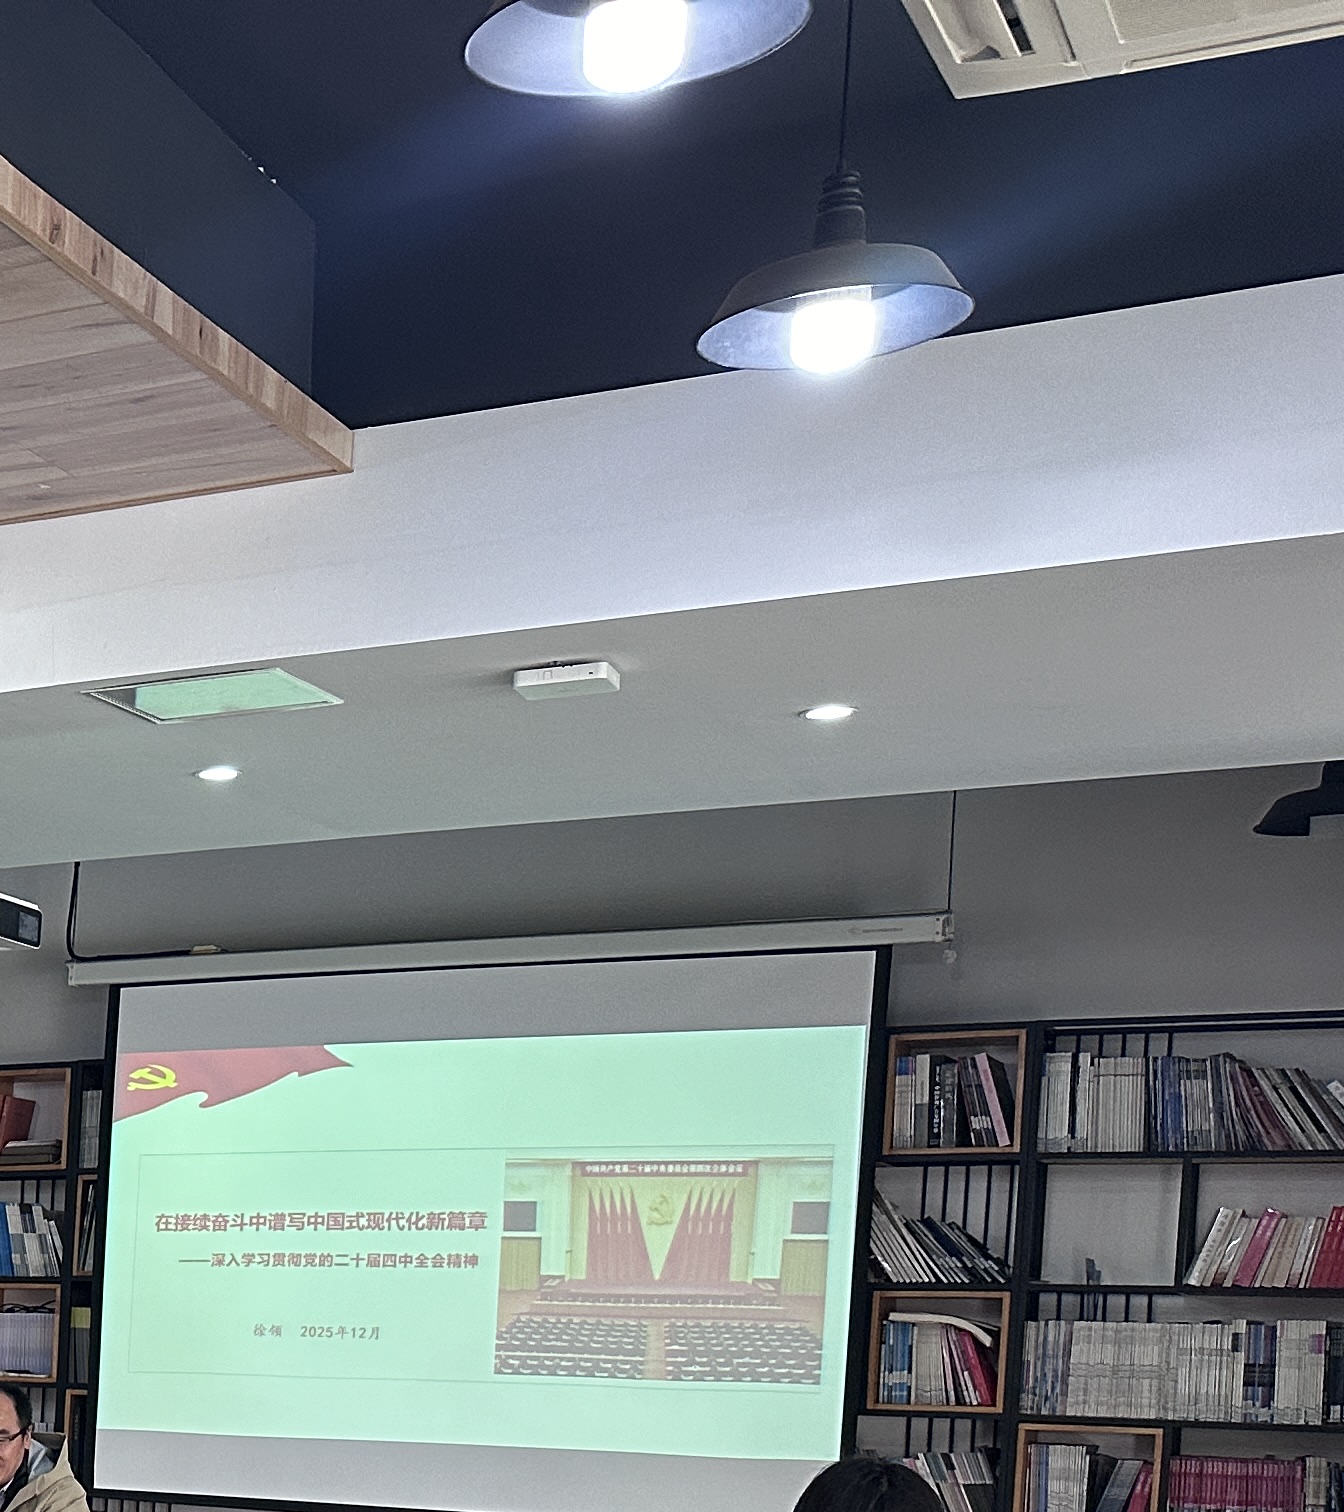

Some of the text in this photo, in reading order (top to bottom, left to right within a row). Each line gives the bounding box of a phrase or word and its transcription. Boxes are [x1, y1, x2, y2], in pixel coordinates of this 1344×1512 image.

[154, 1211, 489, 1232] 在接续奋斗中谱写中国式现代化新篇章
[299, 1325, 380, 1341] 2025年12月
